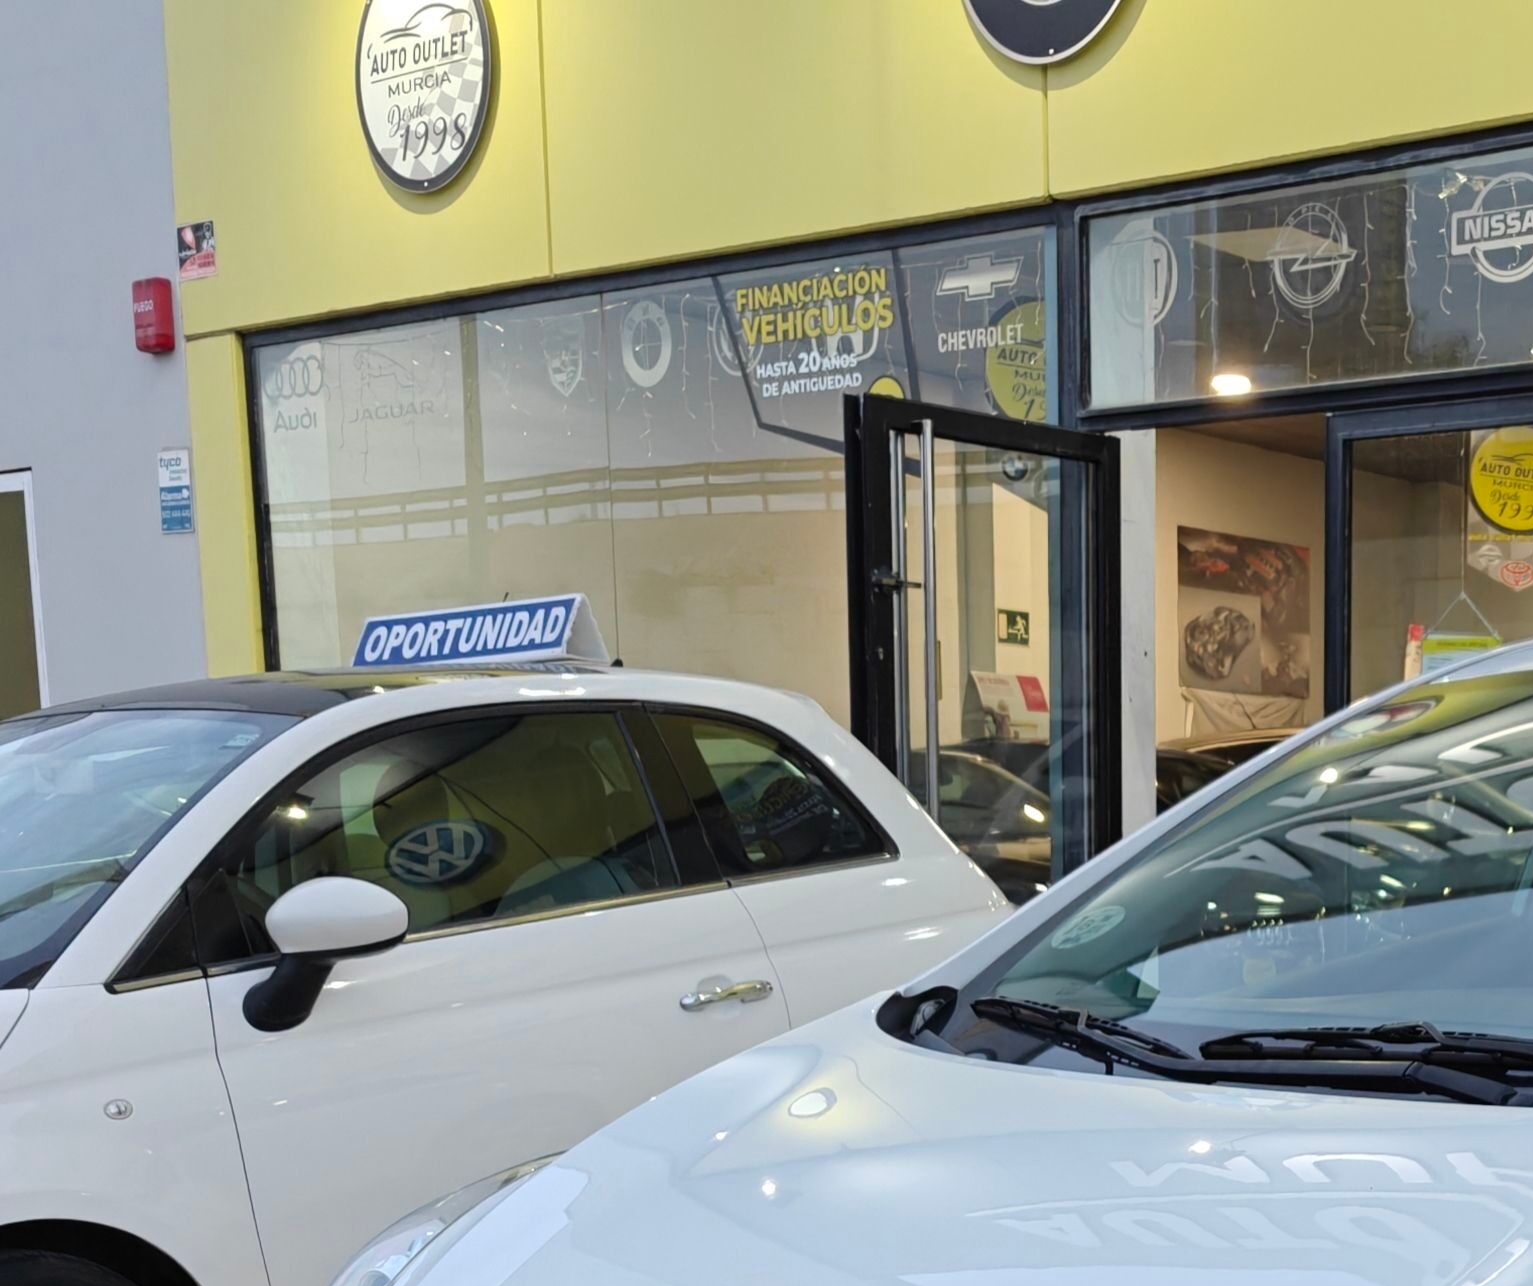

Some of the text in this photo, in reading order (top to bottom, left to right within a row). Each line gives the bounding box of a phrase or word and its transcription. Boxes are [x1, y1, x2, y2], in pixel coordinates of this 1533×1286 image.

[370, 30, 469, 77] AUTO OUTLET
[387, 70, 452, 98] MURCIA
[387, 96, 427, 138] Desde
[400, 112, 467, 161] 1998
[736, 265, 886, 312] FINANCIACIÓN
[742, 297, 894, 345] VEHÍCULOS
[938, 323, 1024, 353] CHEVROLET
[756, 351, 858, 379] HASTA 20 AÑOS
[762, 372, 863, 397] DE ANTIGUEDAD
[273, 406, 318, 433] Audi
[349, 401, 435, 423] JAGUAR
[159, 456, 182, 471] tyco
[1480, 461, 1510, 476] AUTO
[363, 606, 566, 662] OPORTUNIDAD
